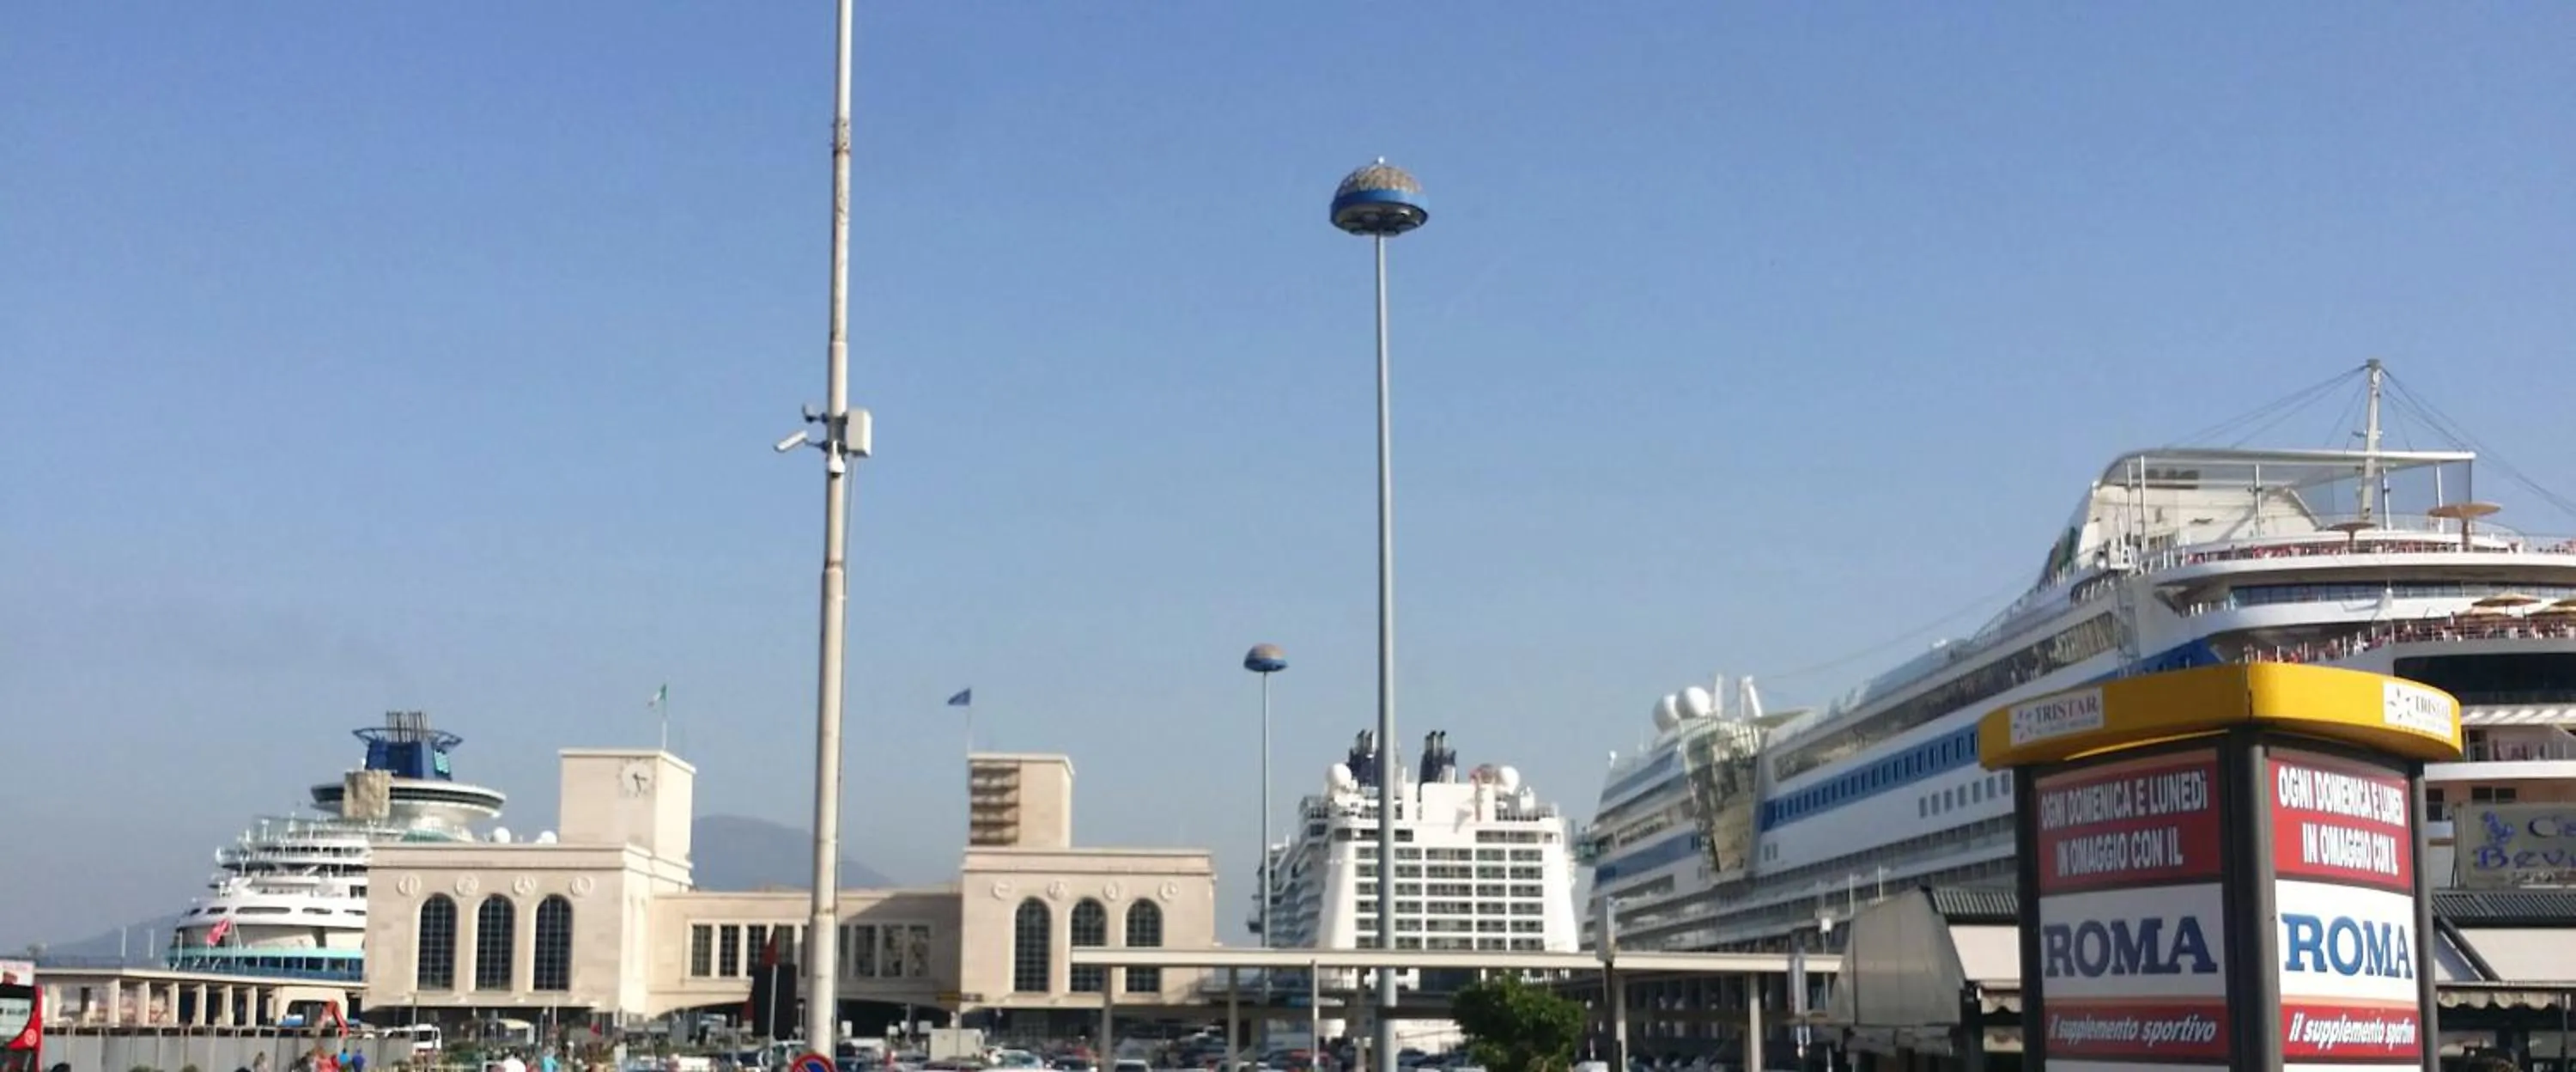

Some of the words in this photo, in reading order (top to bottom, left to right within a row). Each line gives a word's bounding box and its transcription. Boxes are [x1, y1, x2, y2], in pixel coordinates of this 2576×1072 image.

[2035, 694, 2098, 724] TRISTAR
[2040, 790, 2066, 831] OGNI
[2067, 780, 2133, 825] DOMENICA
[2136, 778, 2147, 816] E
[2278, 765, 2314, 810] OGNI
[2314, 770, 2373, 819] DOMENICA
[2371, 781, 2382, 821] E
[2057, 840, 2069, 878] IN
[2069, 831, 2128, 874] OMAGGIO
[2130, 828, 2163, 869] CON
[2167, 825, 2184, 866] IL
[2302, 822, 2318, 864] IN
[2319, 824, 2372, 872] OMAGGIO
[2372, 831, 2391, 875] CON
[2043, 916, 2218, 978] ROMA
[2280, 911, 2414, 980] ROMA
[2055, 1013, 2140, 1046] supplemento
[2141, 1014, 2217, 1048] sportivo
[2302, 1012, 2385, 1051] supplemento
